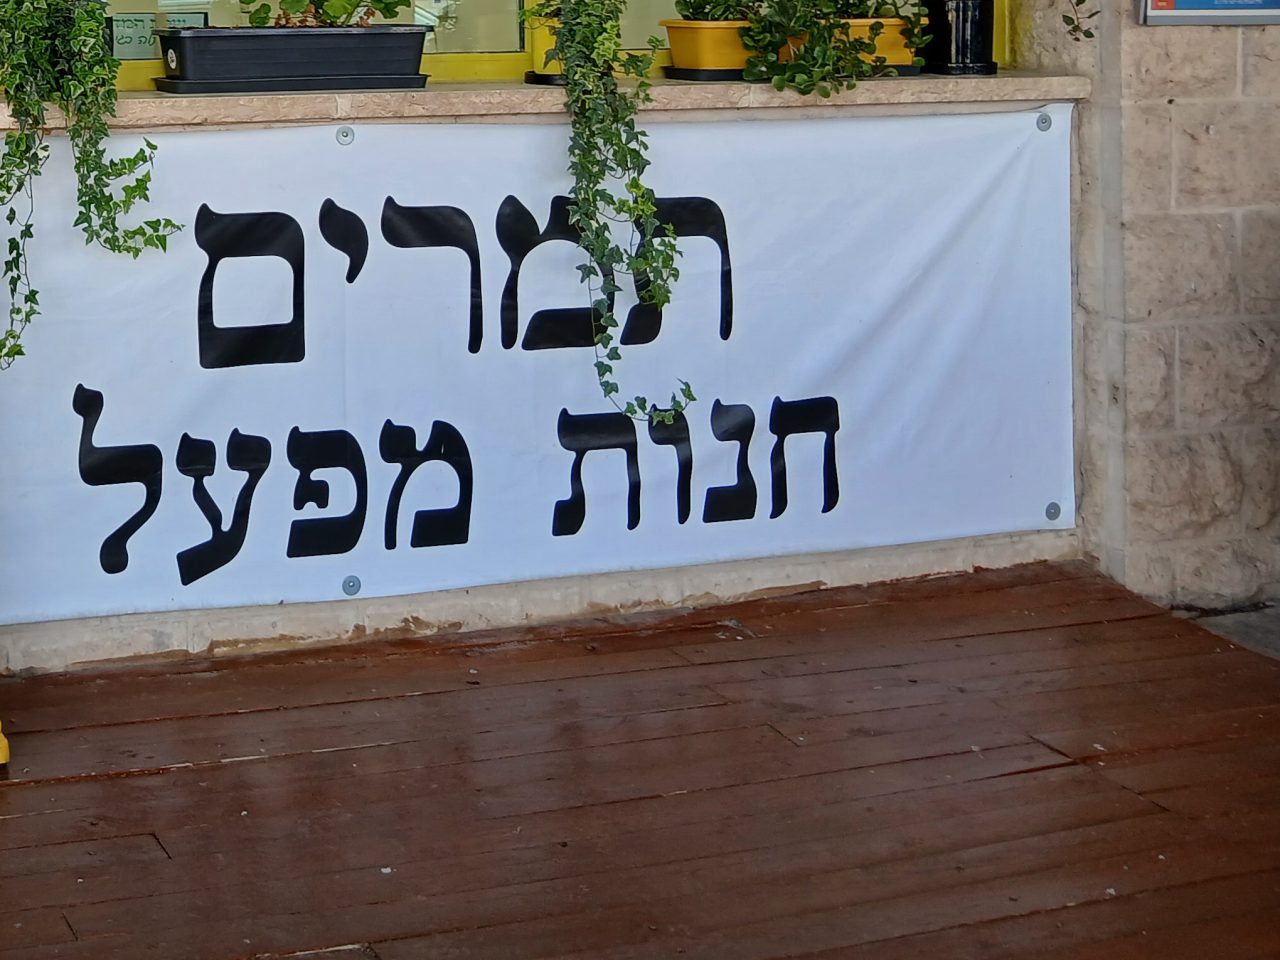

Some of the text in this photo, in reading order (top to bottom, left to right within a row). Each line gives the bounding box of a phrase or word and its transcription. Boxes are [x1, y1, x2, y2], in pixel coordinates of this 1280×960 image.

[194, 194, 734, 370] תמרים
[72, 382, 841, 588] חנות מפעל
